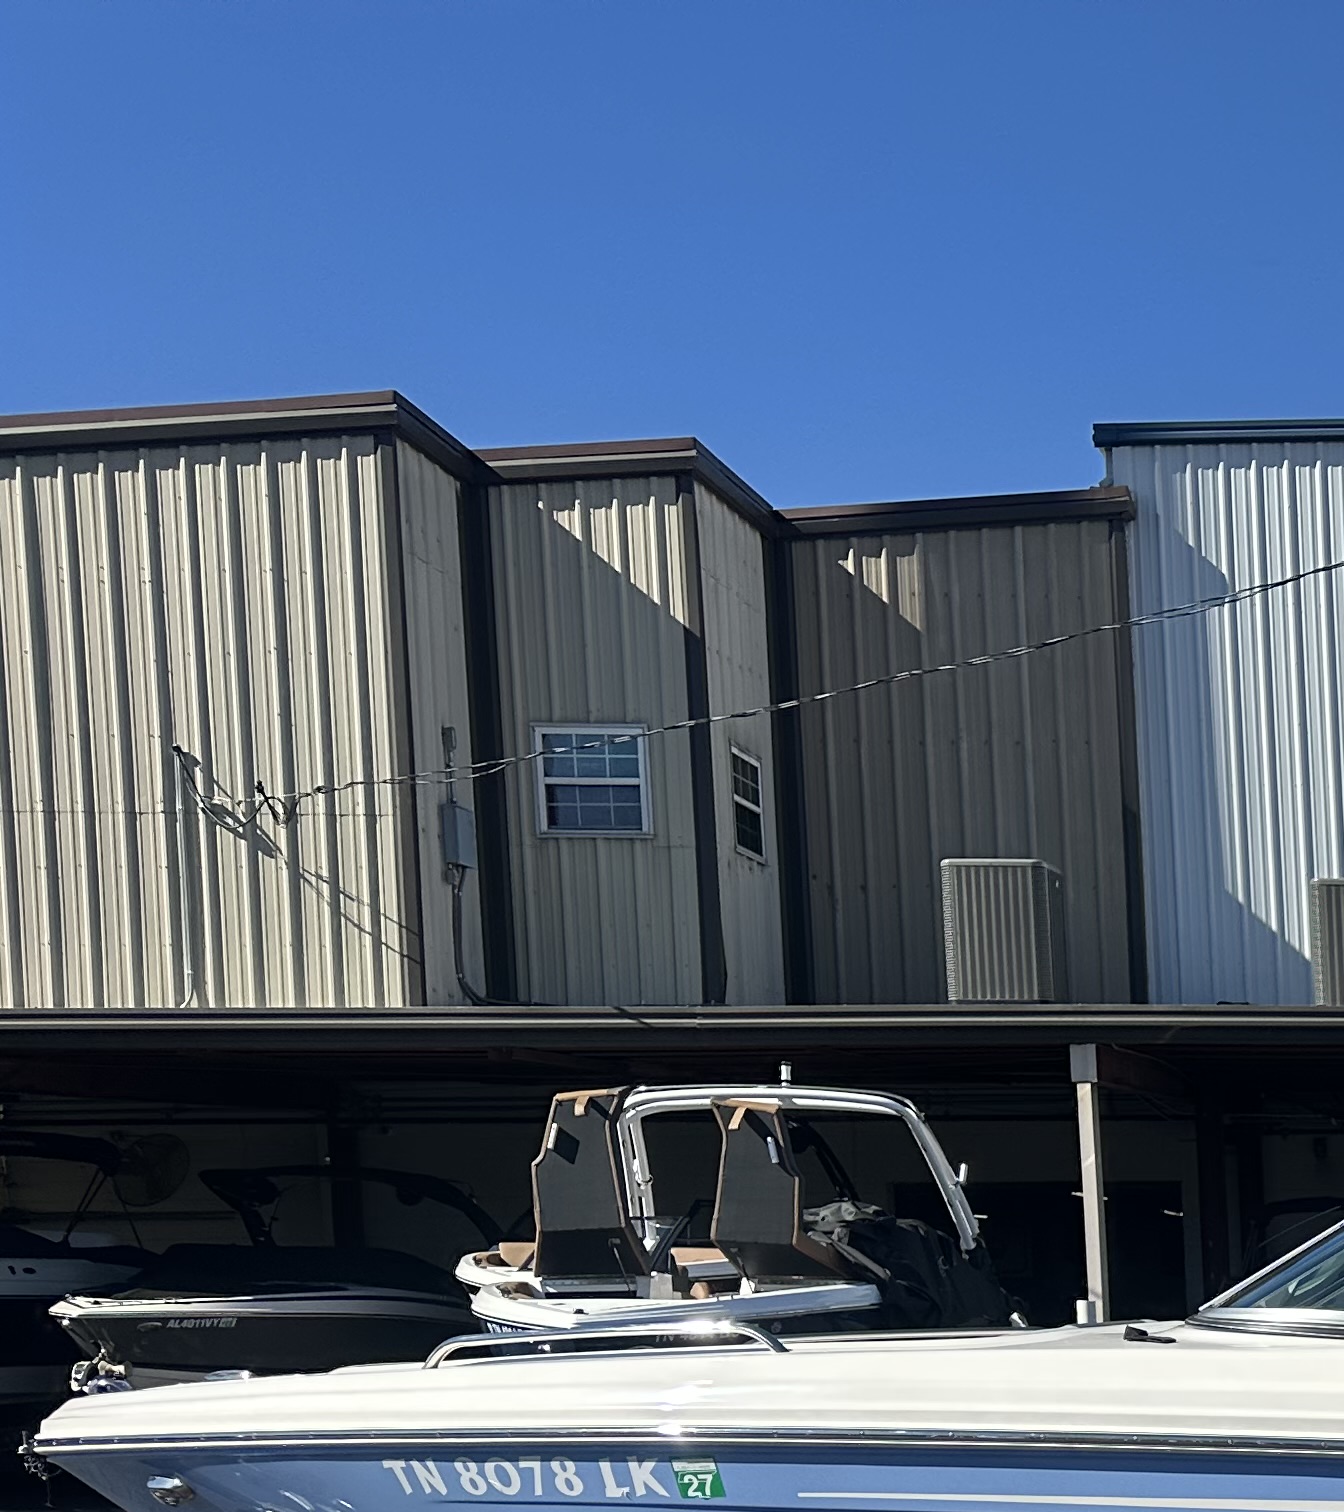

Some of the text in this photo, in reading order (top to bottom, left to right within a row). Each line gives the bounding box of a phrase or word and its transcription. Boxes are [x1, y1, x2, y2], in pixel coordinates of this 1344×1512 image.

[382, 1455, 671, 1499] TN 8078 LK
[683, 1473, 713, 1498] 27
